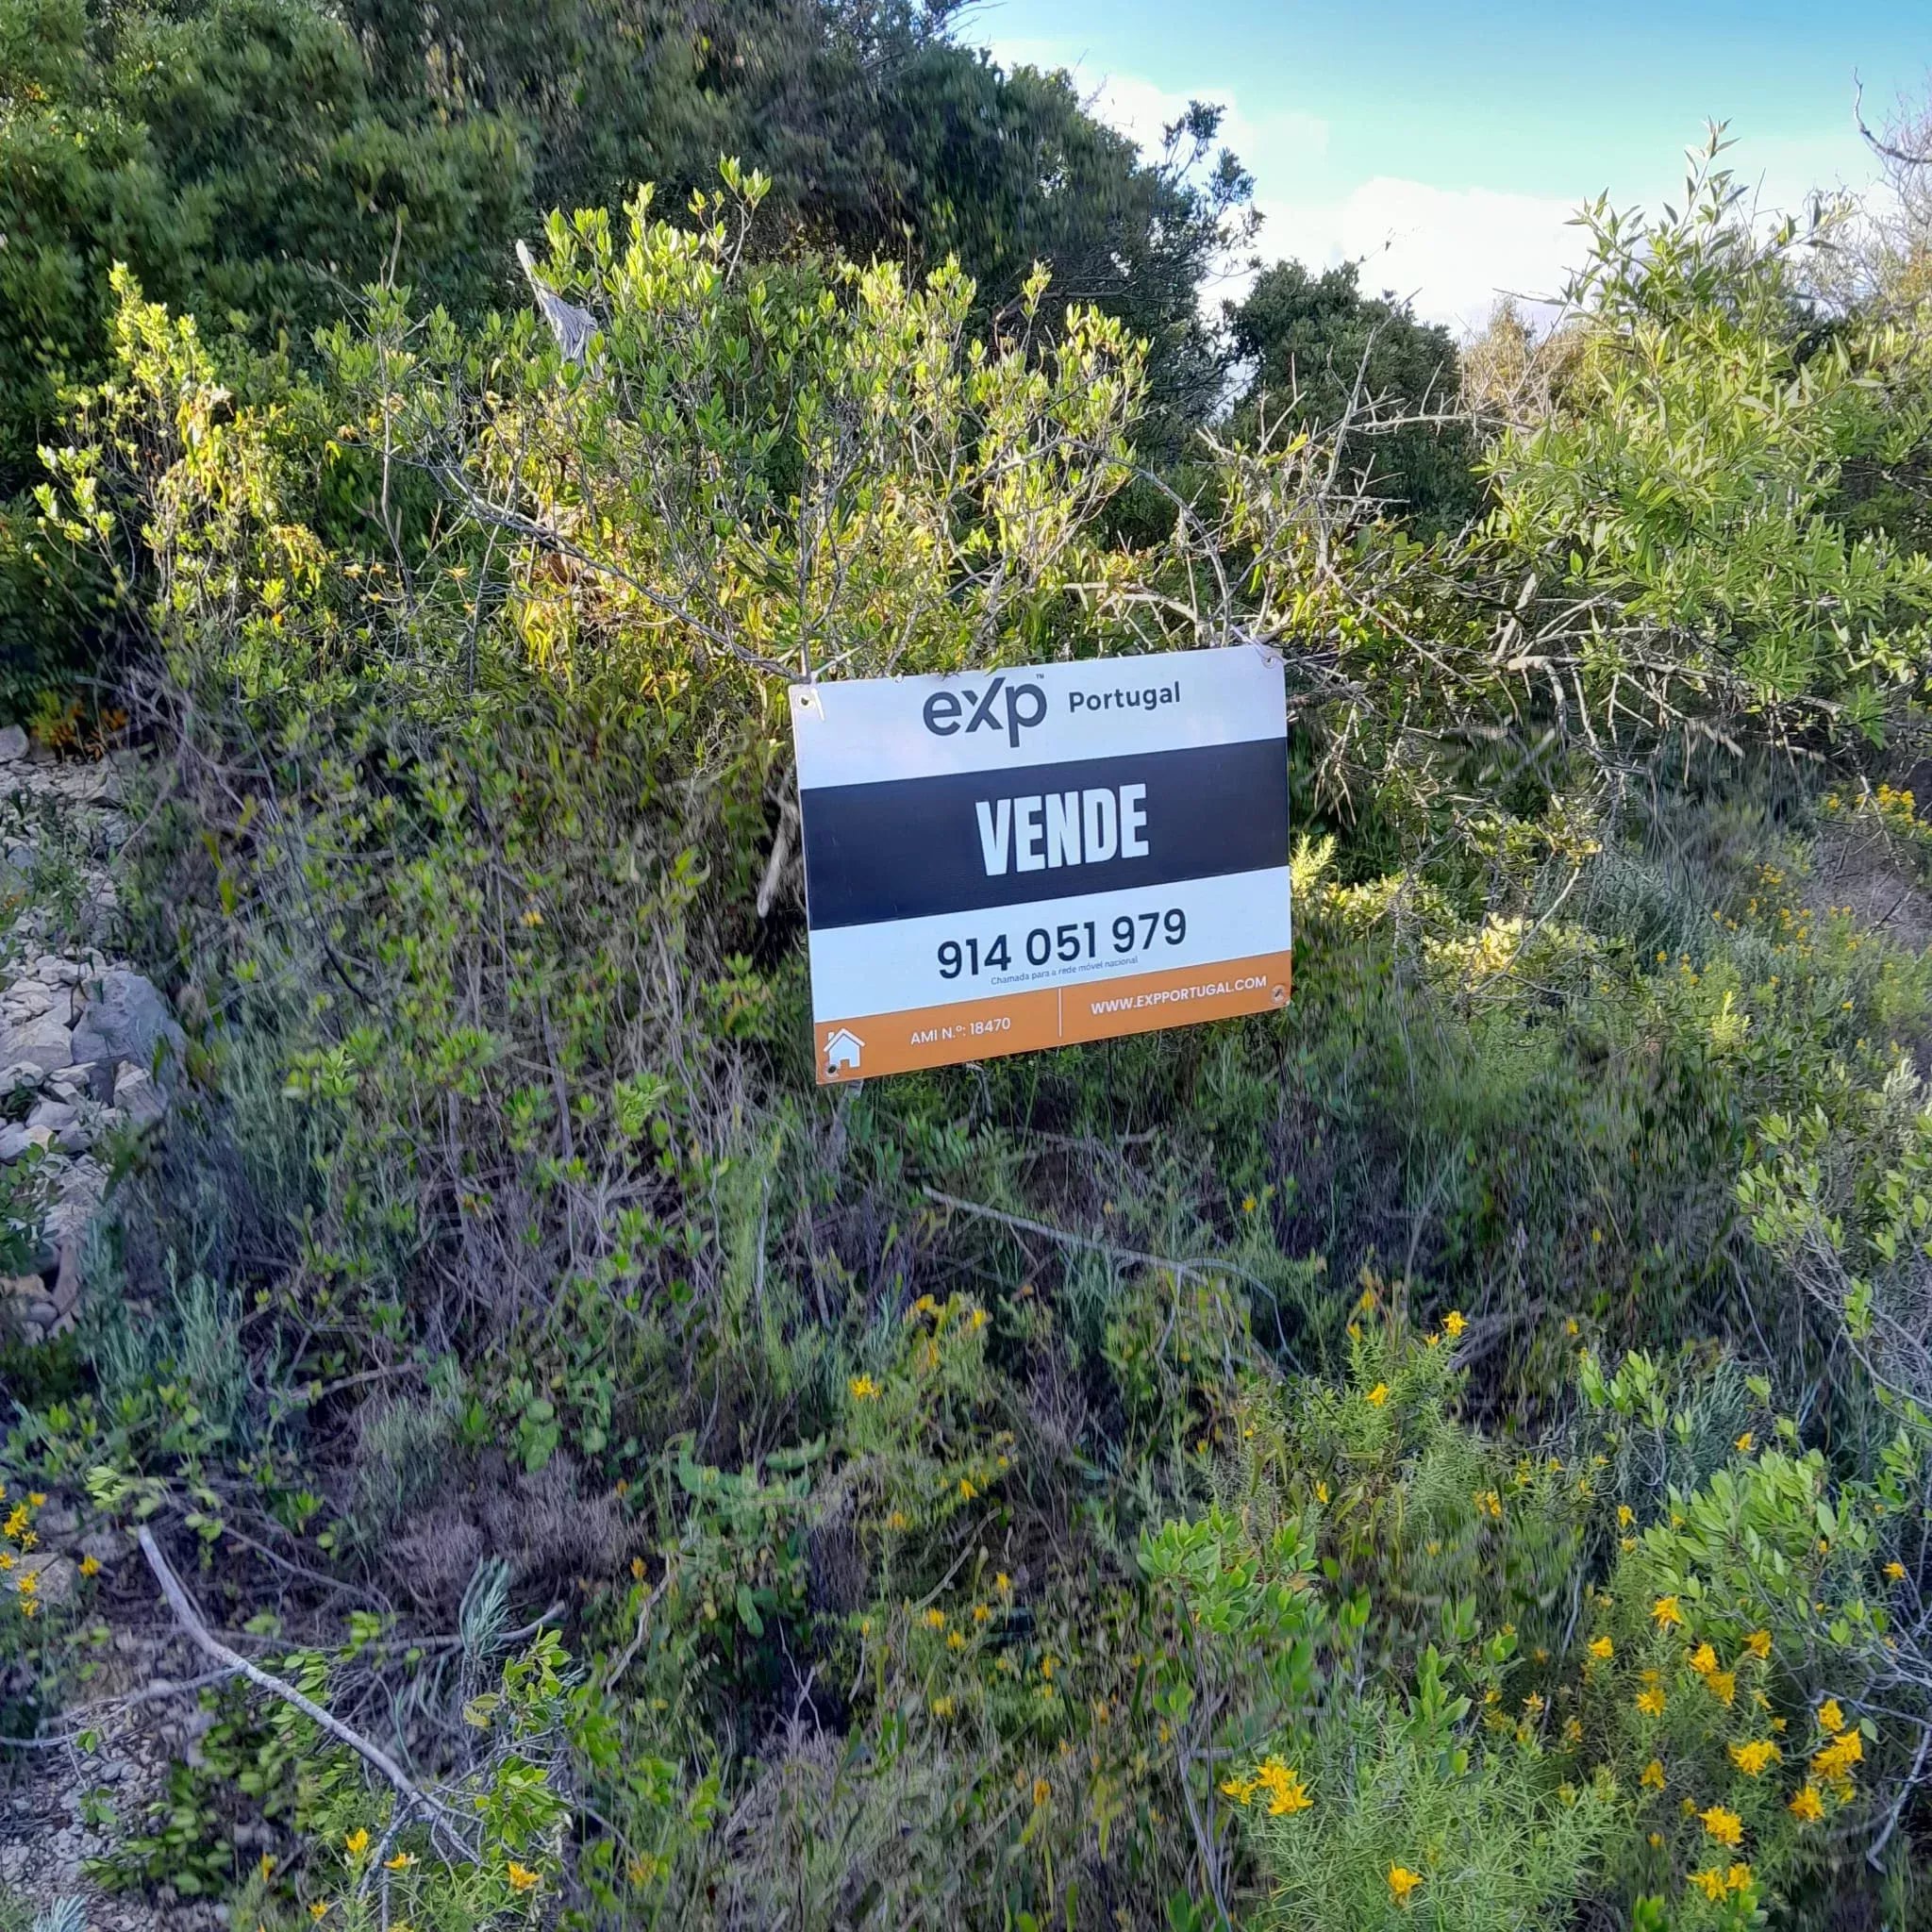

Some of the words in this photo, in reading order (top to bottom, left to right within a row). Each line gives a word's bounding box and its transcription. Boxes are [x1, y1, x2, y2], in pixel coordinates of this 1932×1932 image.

[1069, 681, 1180, 713] Portugal
[975, 783, 1149, 876] VENDE
[937, 934, 1011, 979] 914
[1025, 921, 1097, 967] 051
[1111, 908, 1187, 953] 979
[991, 973, 1029, 985] Chamada
[1031, 970, 1050, 981] para
[1058, 966, 1076, 974] rede
[1078, 961, 1103, 972] móvel
[1104, 956, 1139, 968] nacional
[1090, 975, 1267, 1015] WWW.EXPPORTUGAL.COM
[910, 1028, 938, 1045] AMI
[970, 1017, 1011, 1035] 18470
